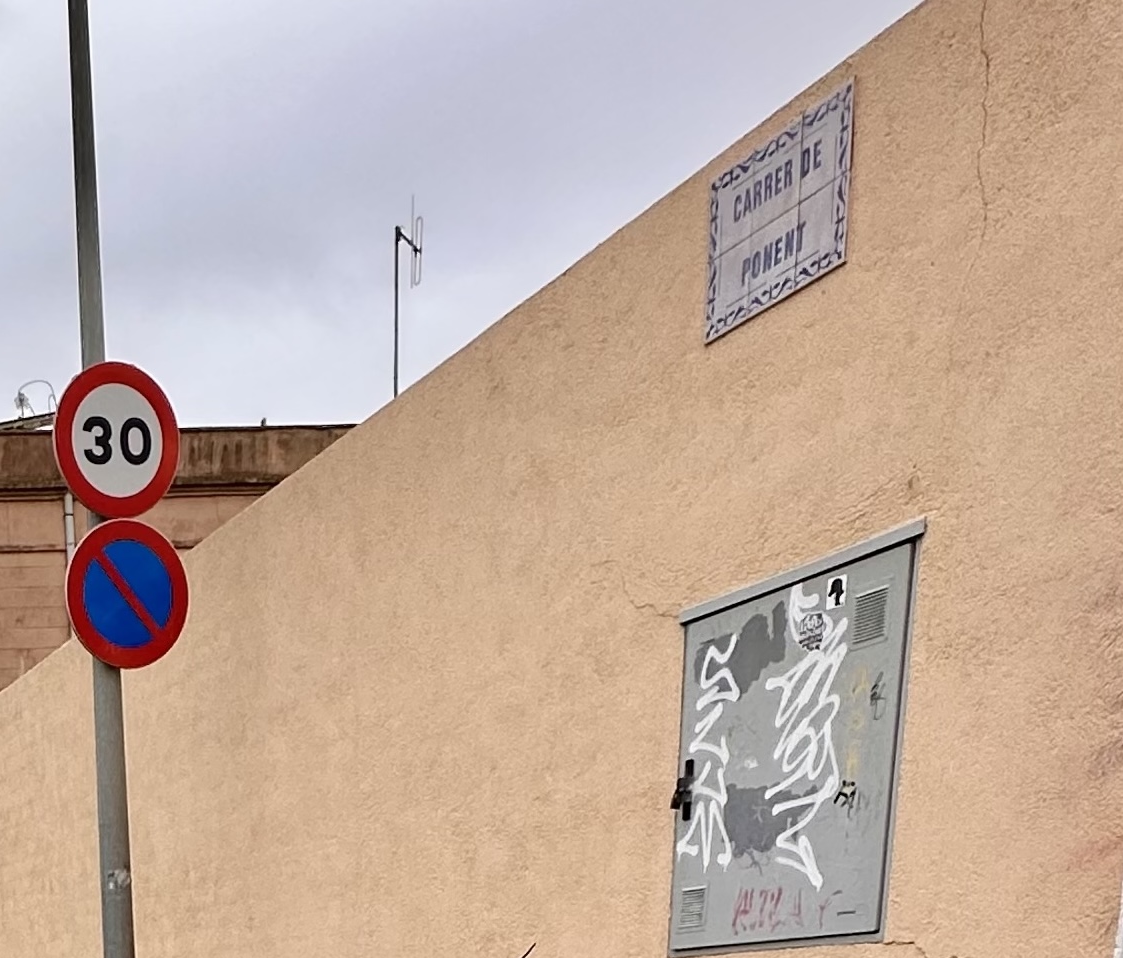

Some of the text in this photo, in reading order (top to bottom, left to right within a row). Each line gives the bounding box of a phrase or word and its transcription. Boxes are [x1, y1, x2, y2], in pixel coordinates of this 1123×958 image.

[733, 138, 823, 223] CARRER DE
[741, 220, 806, 286] PONENT
[82, 416, 152, 465] 30
